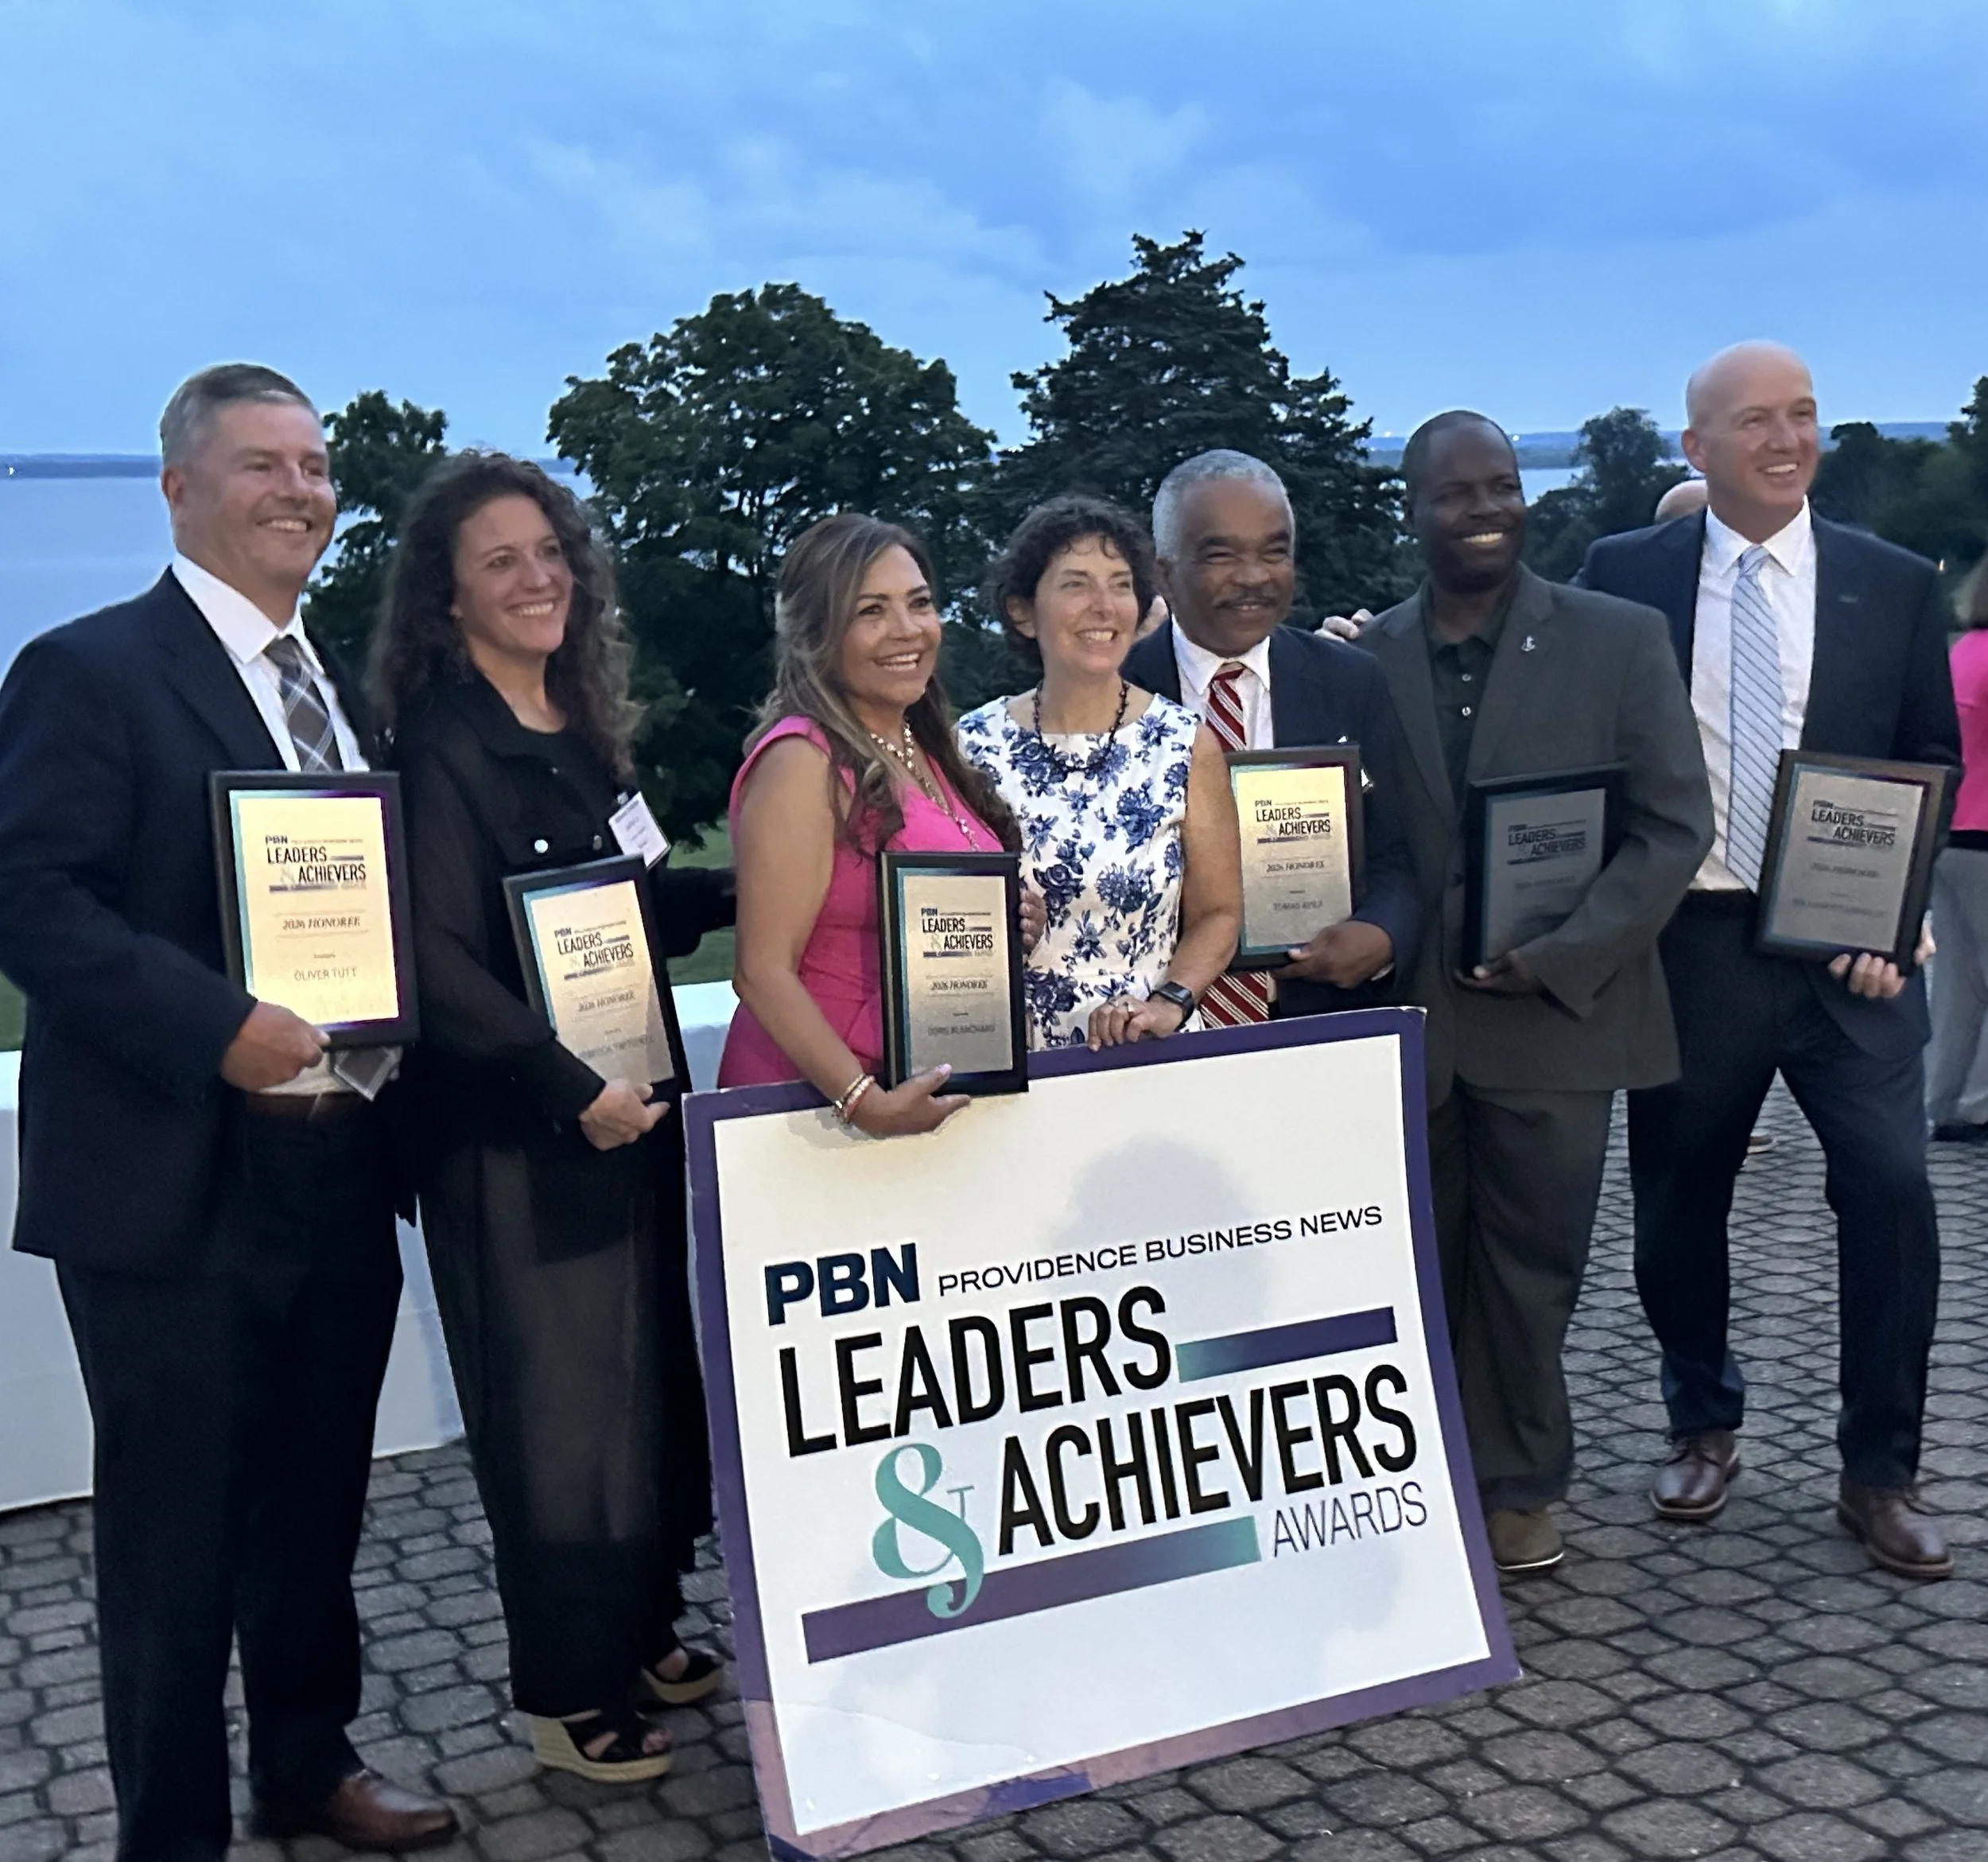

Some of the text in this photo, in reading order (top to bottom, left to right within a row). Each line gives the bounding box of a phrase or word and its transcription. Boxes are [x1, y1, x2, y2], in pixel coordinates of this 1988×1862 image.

[1256, 807, 1301, 822] LEADERS
[1811, 809, 1864, 826] LEADERS
[1279, 819, 1331, 836] ACHIEVERS
[1508, 828, 1556, 846] LEADERS
[1833, 827, 1895, 846] ACHIEVERS
[266, 845, 328, 864] LEADERS
[1530, 838, 1586, 857] ACHIEVERS
[298, 864, 367, 883] ACHIEVERS
[922, 918, 965, 933] LEADERS
[557, 932, 603, 954] LEADERS
[943, 934, 993, 950] ACHIEVERS
[584, 943, 634, 968] ACHIEVERS
[763, 1205, 1383, 1326] PBN PROVIDENCE BUSINESS NEWS
[779, 1285, 1172, 1458] LEADERS
[872, 1363, 1419, 1619] & ACHIEVERS
[1273, 1482, 1427, 1558] AWARDS
